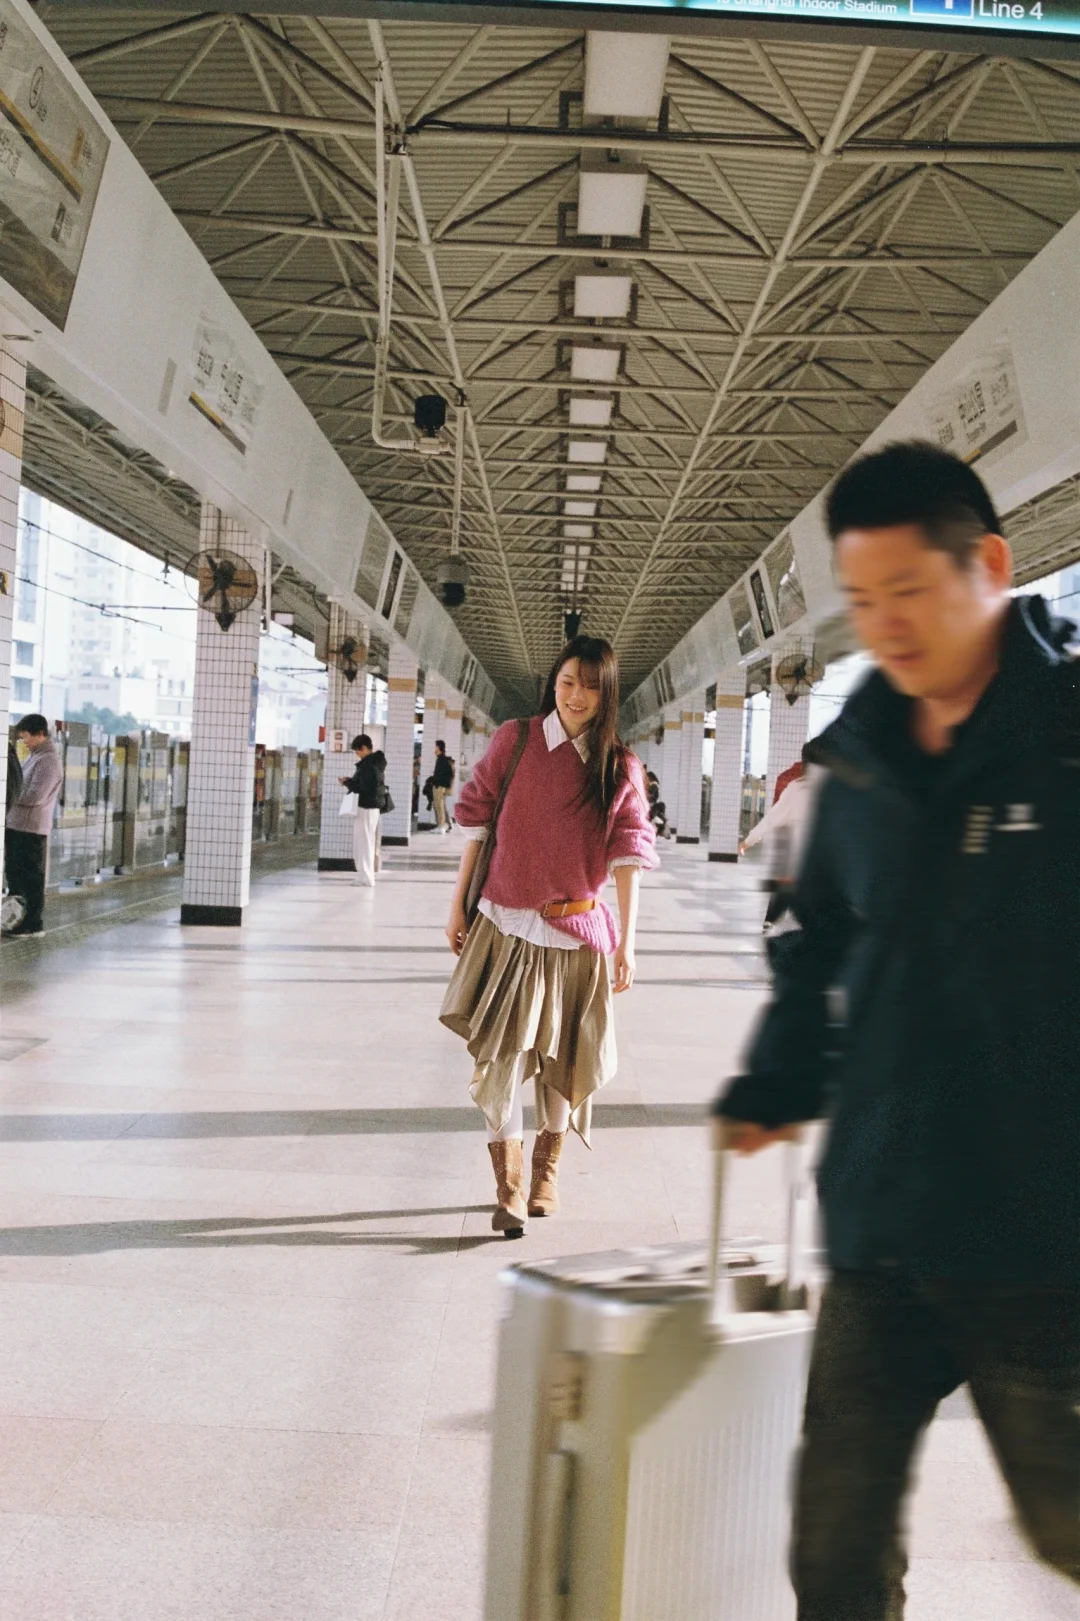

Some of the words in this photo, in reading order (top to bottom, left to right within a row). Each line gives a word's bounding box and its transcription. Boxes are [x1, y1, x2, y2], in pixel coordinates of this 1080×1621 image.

[799, 0, 841, 11] Indoor
[844, 0, 897, 14] Stadium
[979, 0, 1024, 19] Line
[1029, 1, 1044, 20] 4
